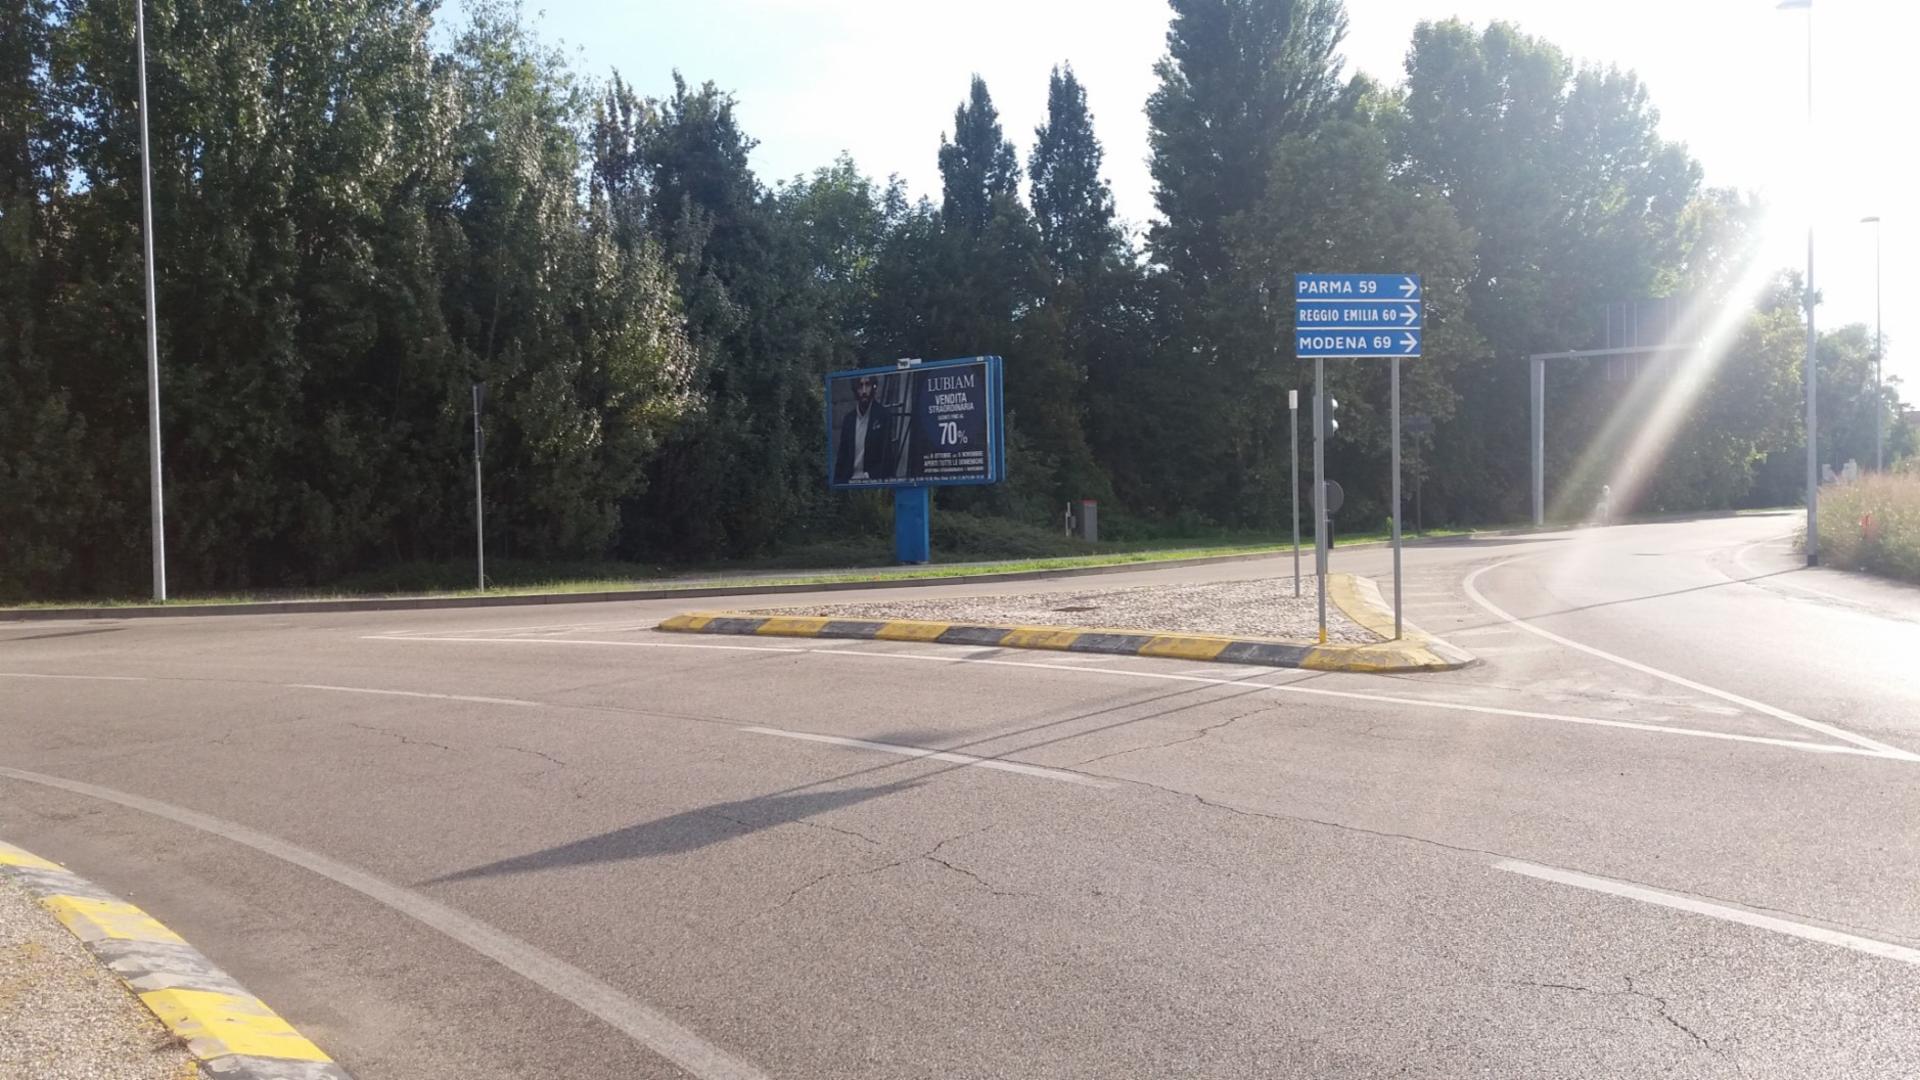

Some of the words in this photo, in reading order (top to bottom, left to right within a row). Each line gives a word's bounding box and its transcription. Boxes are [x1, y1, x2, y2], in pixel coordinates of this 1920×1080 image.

[1299, 281, 1352, 293] PARMA
[1359, 281, 1377, 293] 59
[1300, 309, 1339, 321] REGGIO
[1344, 309, 1379, 321] EMILIA
[1382, 309, 1397, 321] 60
[1300, 336, 1367, 349] MODENA
[1373, 336, 1392, 349] 69
[928, 374, 975, 392] LUBIAM
[935, 393, 968, 406] VENDITA
[928, 402, 974, 414] STRAORDINARIA
[939, 421, 968, 445] 70%
